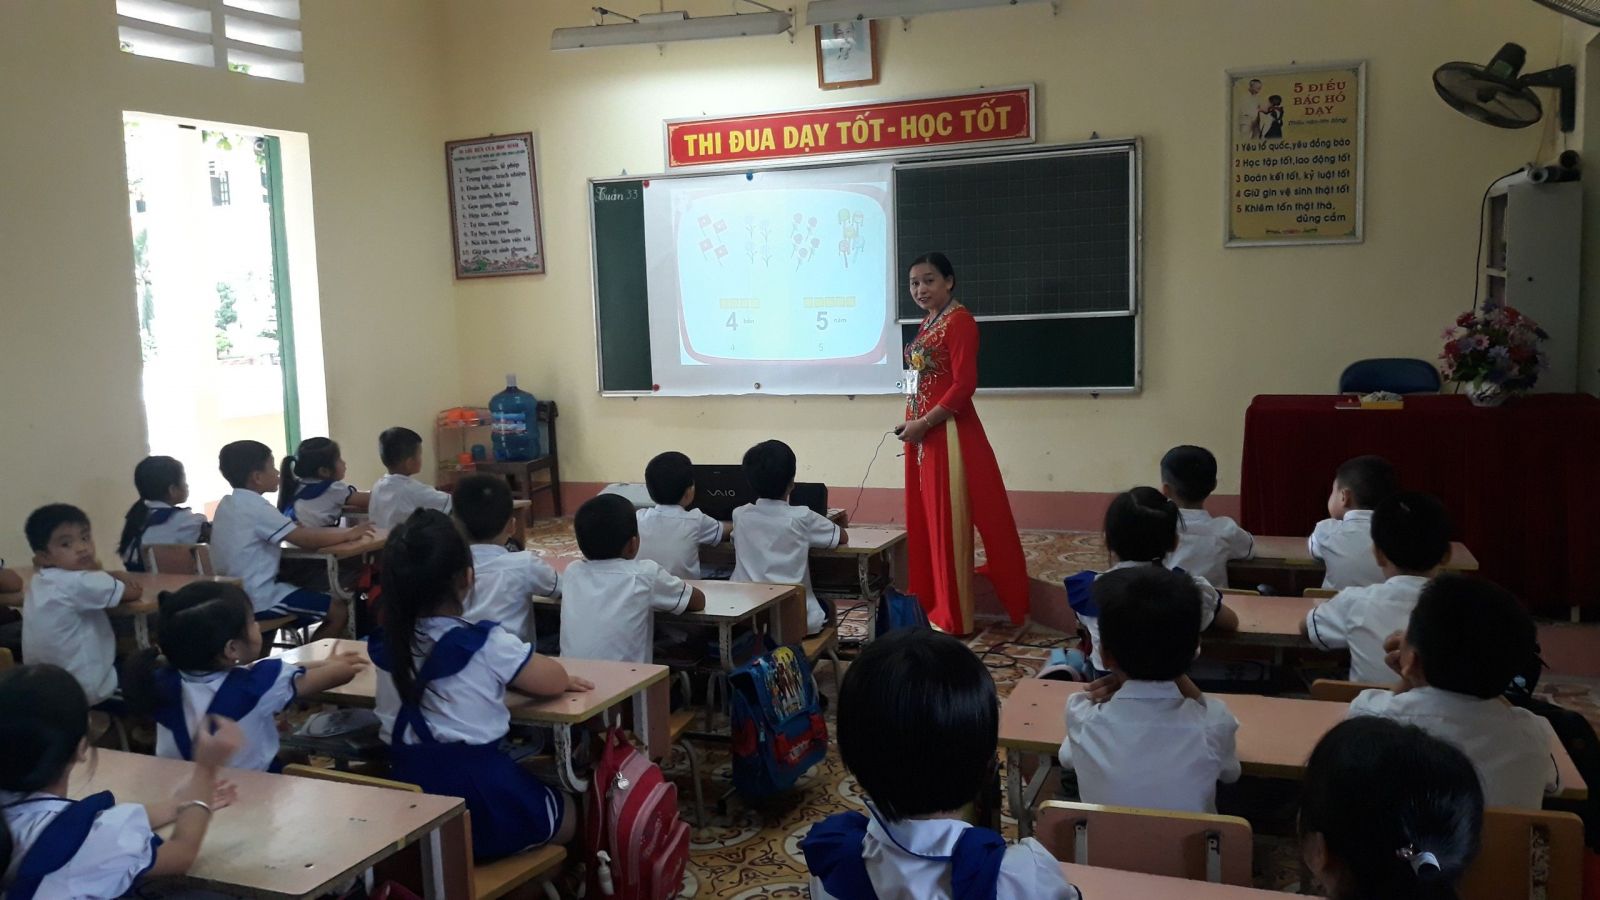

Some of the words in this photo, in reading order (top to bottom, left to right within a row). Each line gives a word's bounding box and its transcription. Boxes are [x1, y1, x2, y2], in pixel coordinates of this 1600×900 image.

[1294, 83, 1303, 93] 5
[1308, 78, 1346, 92] ĐIỀU
[1293, 94, 1320, 105] BÁC
[1305, 106, 1334, 117] DẠY
[683, 133, 722, 156] THI
[729, 128, 776, 153] ĐUA
[784, 122, 829, 152] DẠY
[836, 111, 885, 145] TỐT
[901, 111, 953, 142] HỌC
[960, 98, 1012, 133] TỐT
[1241, 144, 1256, 152] Yêu
[1310, 138, 1331, 149] đồng
[1333, 138, 1351, 146] bào
[1235, 160, 1240, 168] 2
[1243, 160, 1260, 169] Học
[1262, 158, 1278, 168] tập
[1312, 155, 1336, 165] động
[1338, 154, 1350, 162] tốt
[1235, 175, 1241, 183] 3
[1243, 173, 1267, 182] Đoàn
[1270, 172, 1284, 181] kết
[1303, 170, 1314, 181] kỷ
[1317, 171, 1335, 180] luật
[1337, 169, 1350, 178] tốt
[595, 186, 624, 201] Tuần
[626, 190, 638, 200] 33
[1235, 190, 1240, 198] 4
[1243, 188, 1260, 198] Giữ
[1262, 189, 1277, 198] gìn
[1280, 188, 1291, 197] vệ
[1294, 186, 1312, 195] sinh
[1315, 185, 1334, 195] thật
[1336, 184, 1350, 193] tốt
[1244, 203, 1274, 212] Khiêm
[1276, 202, 1292, 211] tốn
[1295, 201, 1314, 211] thật
[725, 311, 738, 331] 4
[816, 311, 828, 331] 5
[818, 343, 824, 351] 5
[706, 489, 736, 497] VAIO
